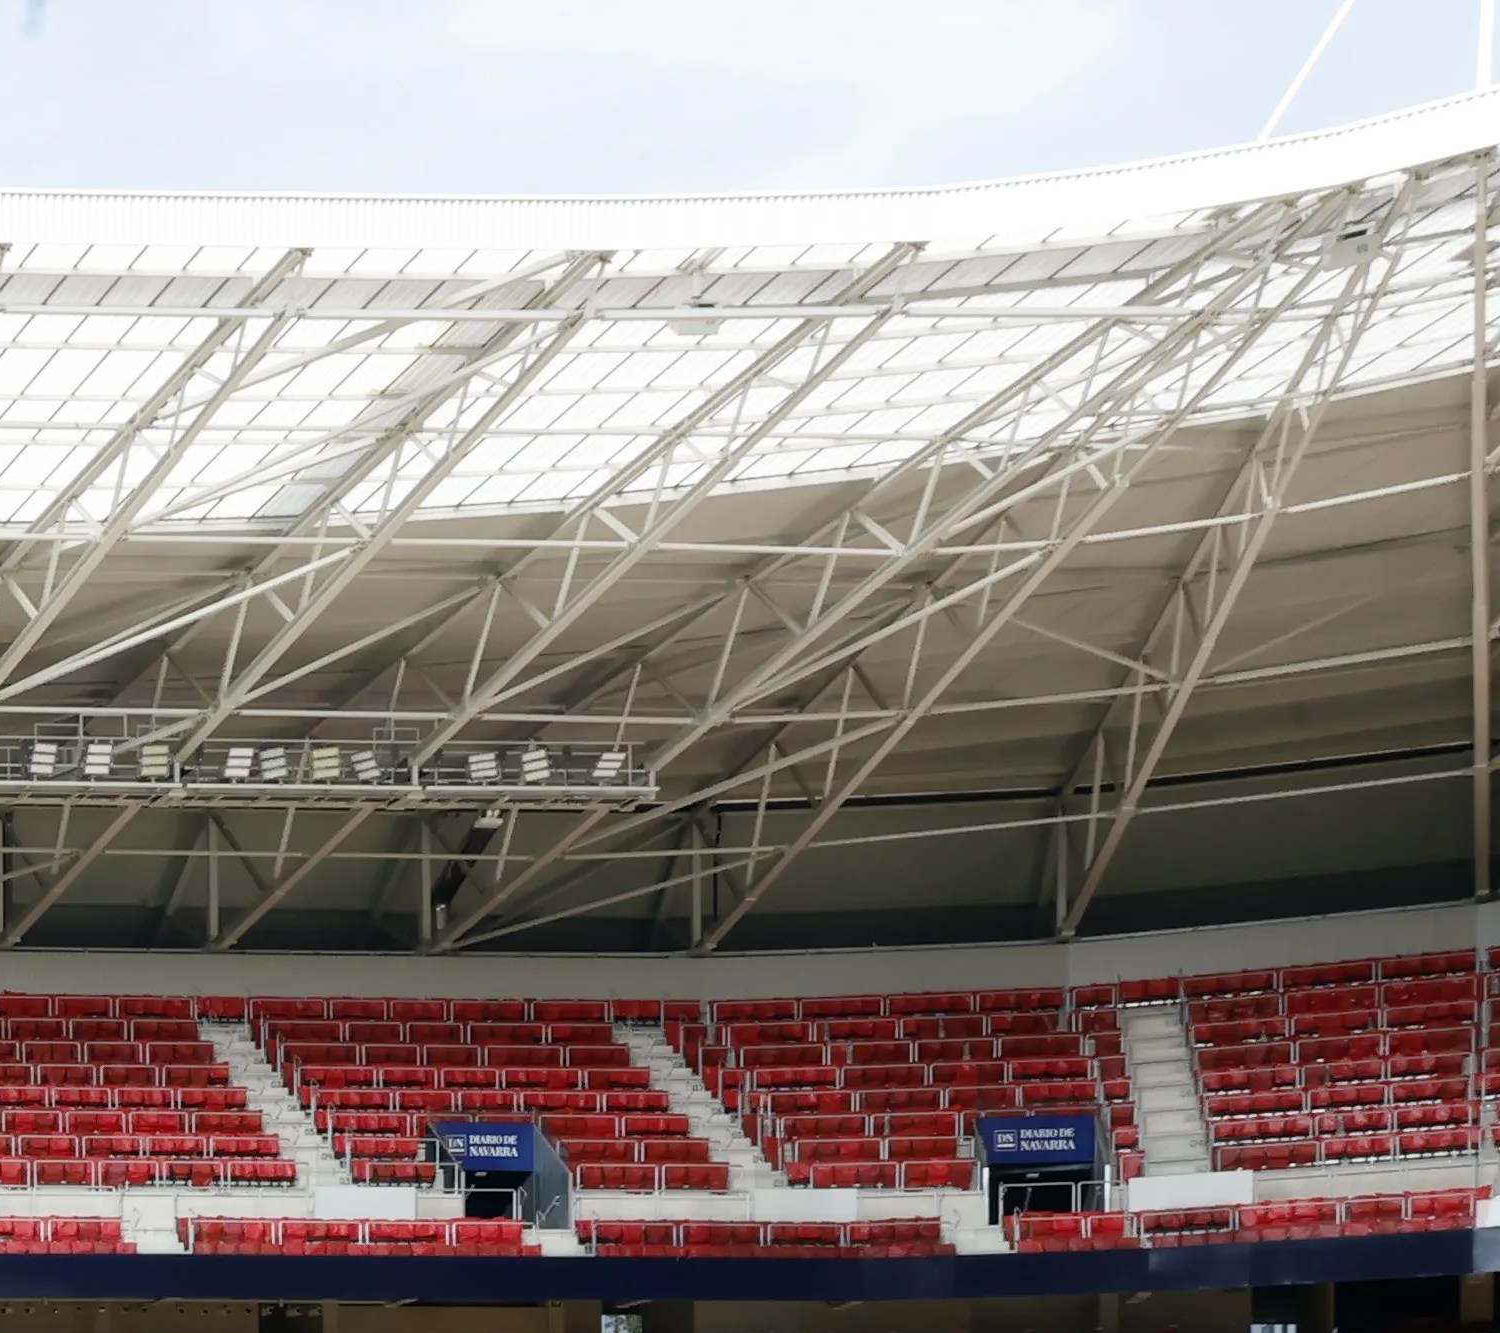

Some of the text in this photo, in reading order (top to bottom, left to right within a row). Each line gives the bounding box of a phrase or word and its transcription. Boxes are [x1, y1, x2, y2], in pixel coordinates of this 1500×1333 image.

[1020, 1128, 1074, 1139] DIARIO DE
[469, 1135, 517, 1145] DIARIO DE
[1020, 1140, 1075, 1151] NAVARRA
[469, 1146, 518, 1157] NAVARRA
